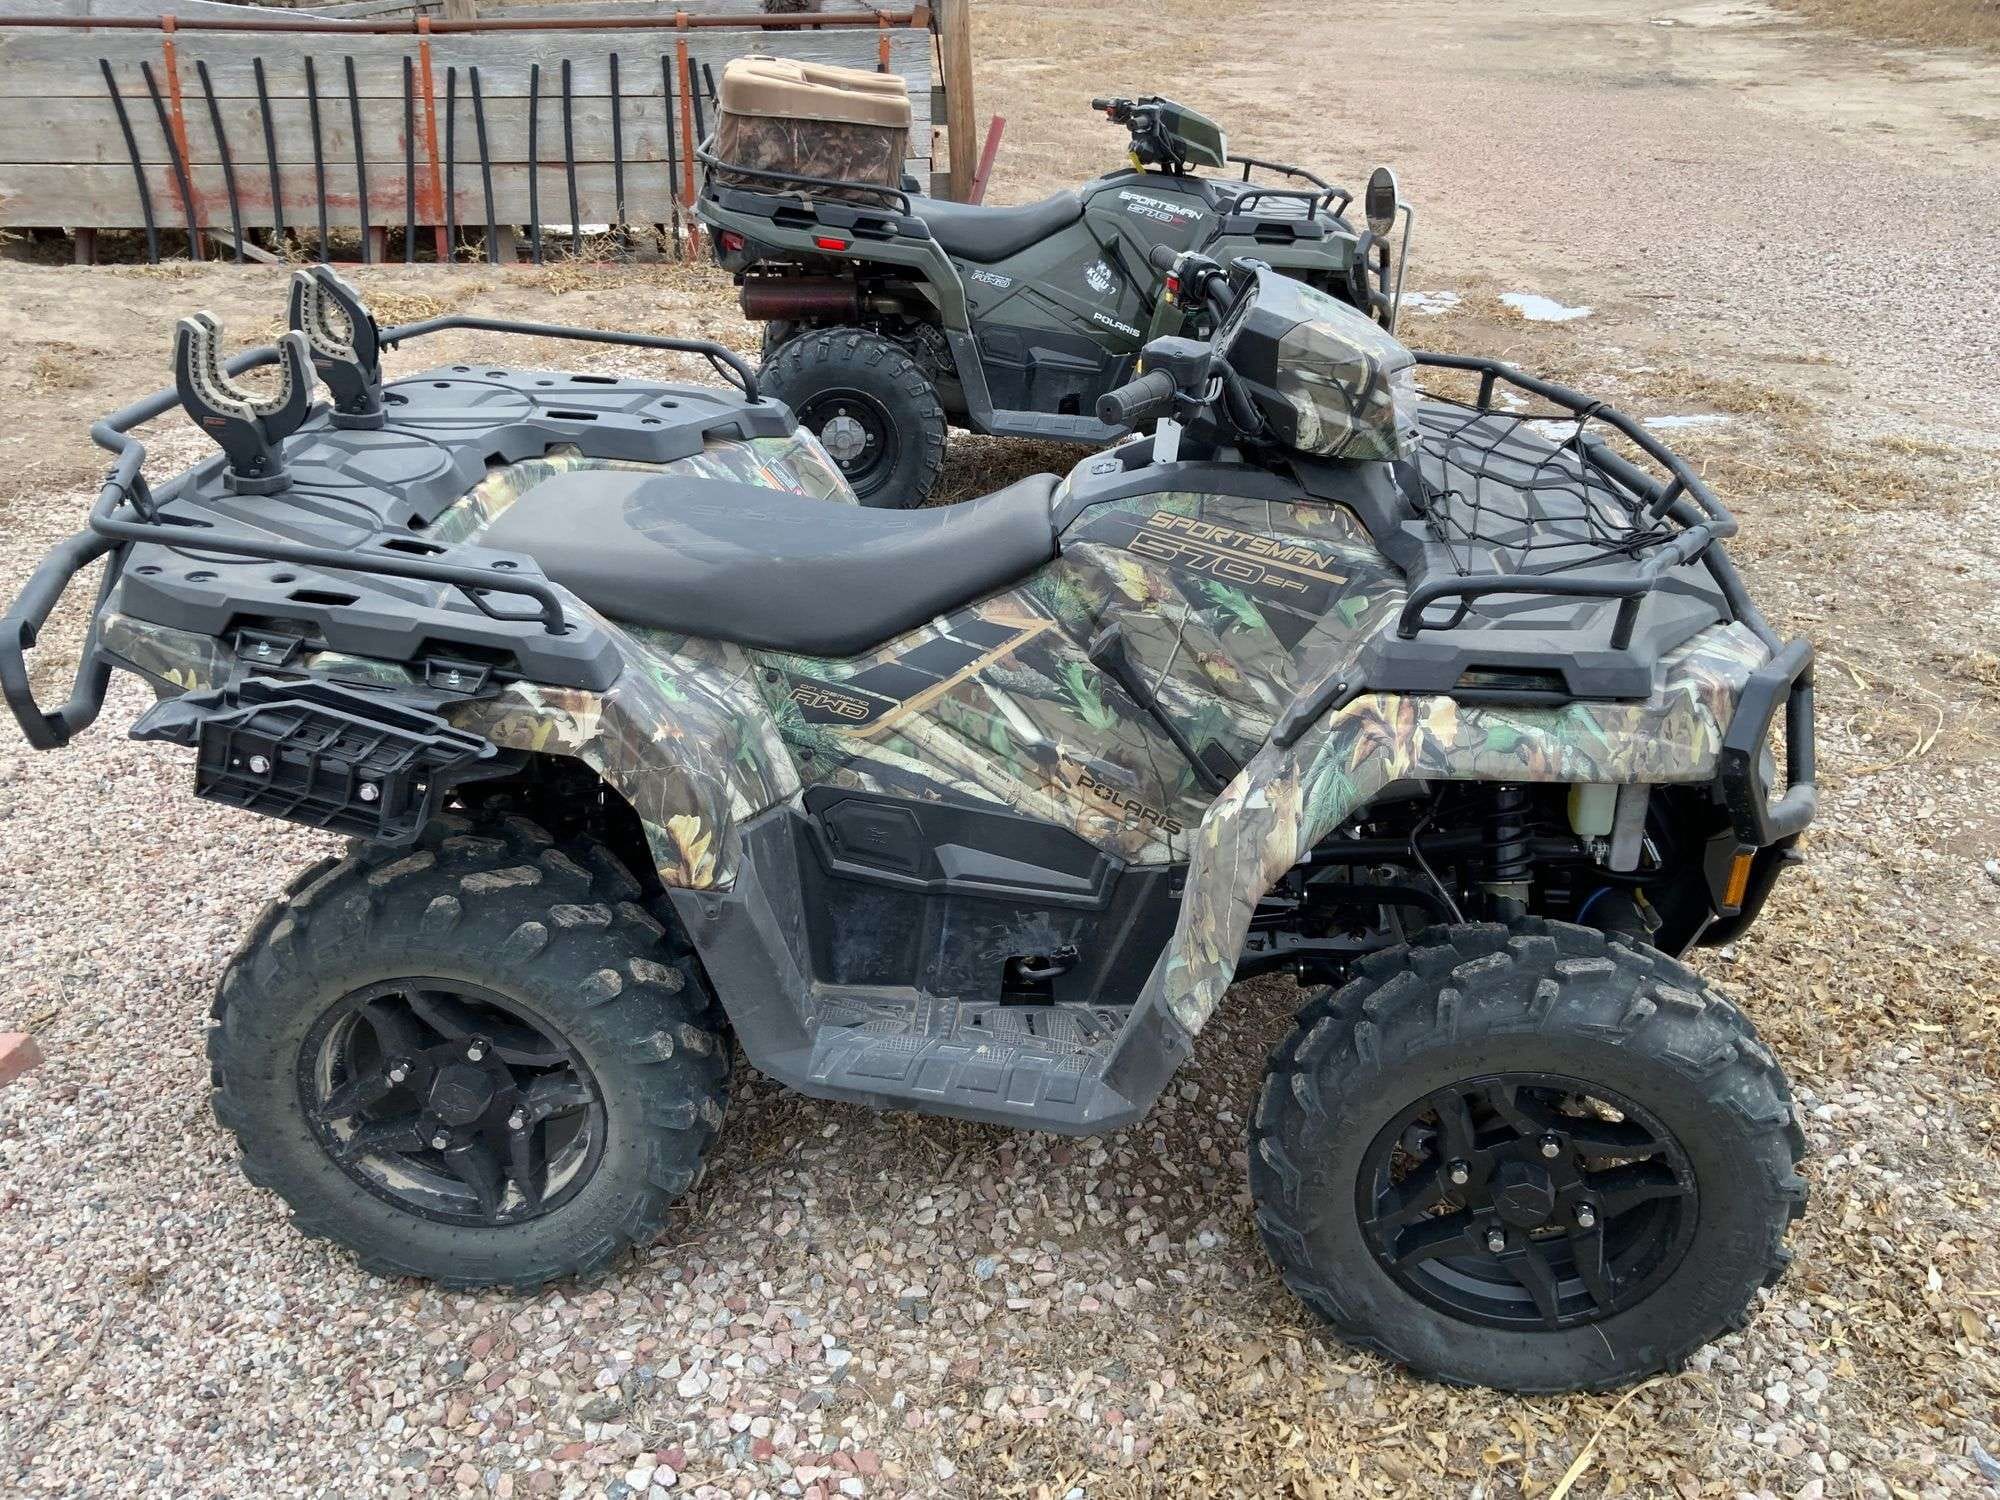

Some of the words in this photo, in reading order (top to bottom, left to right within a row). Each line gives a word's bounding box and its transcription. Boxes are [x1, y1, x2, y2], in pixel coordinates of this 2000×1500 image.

[1118, 191, 1204, 220] SPORTSMAN
[1093, 312, 1141, 338] POLARIS
[1126, 531, 1266, 585] 570
[1262, 574, 1311, 594] EFI
[1147, 510, 1337, 570] SPORTSMAN
[788, 688, 870, 720] AWD
[1076, 774, 1183, 836] POLARIS
